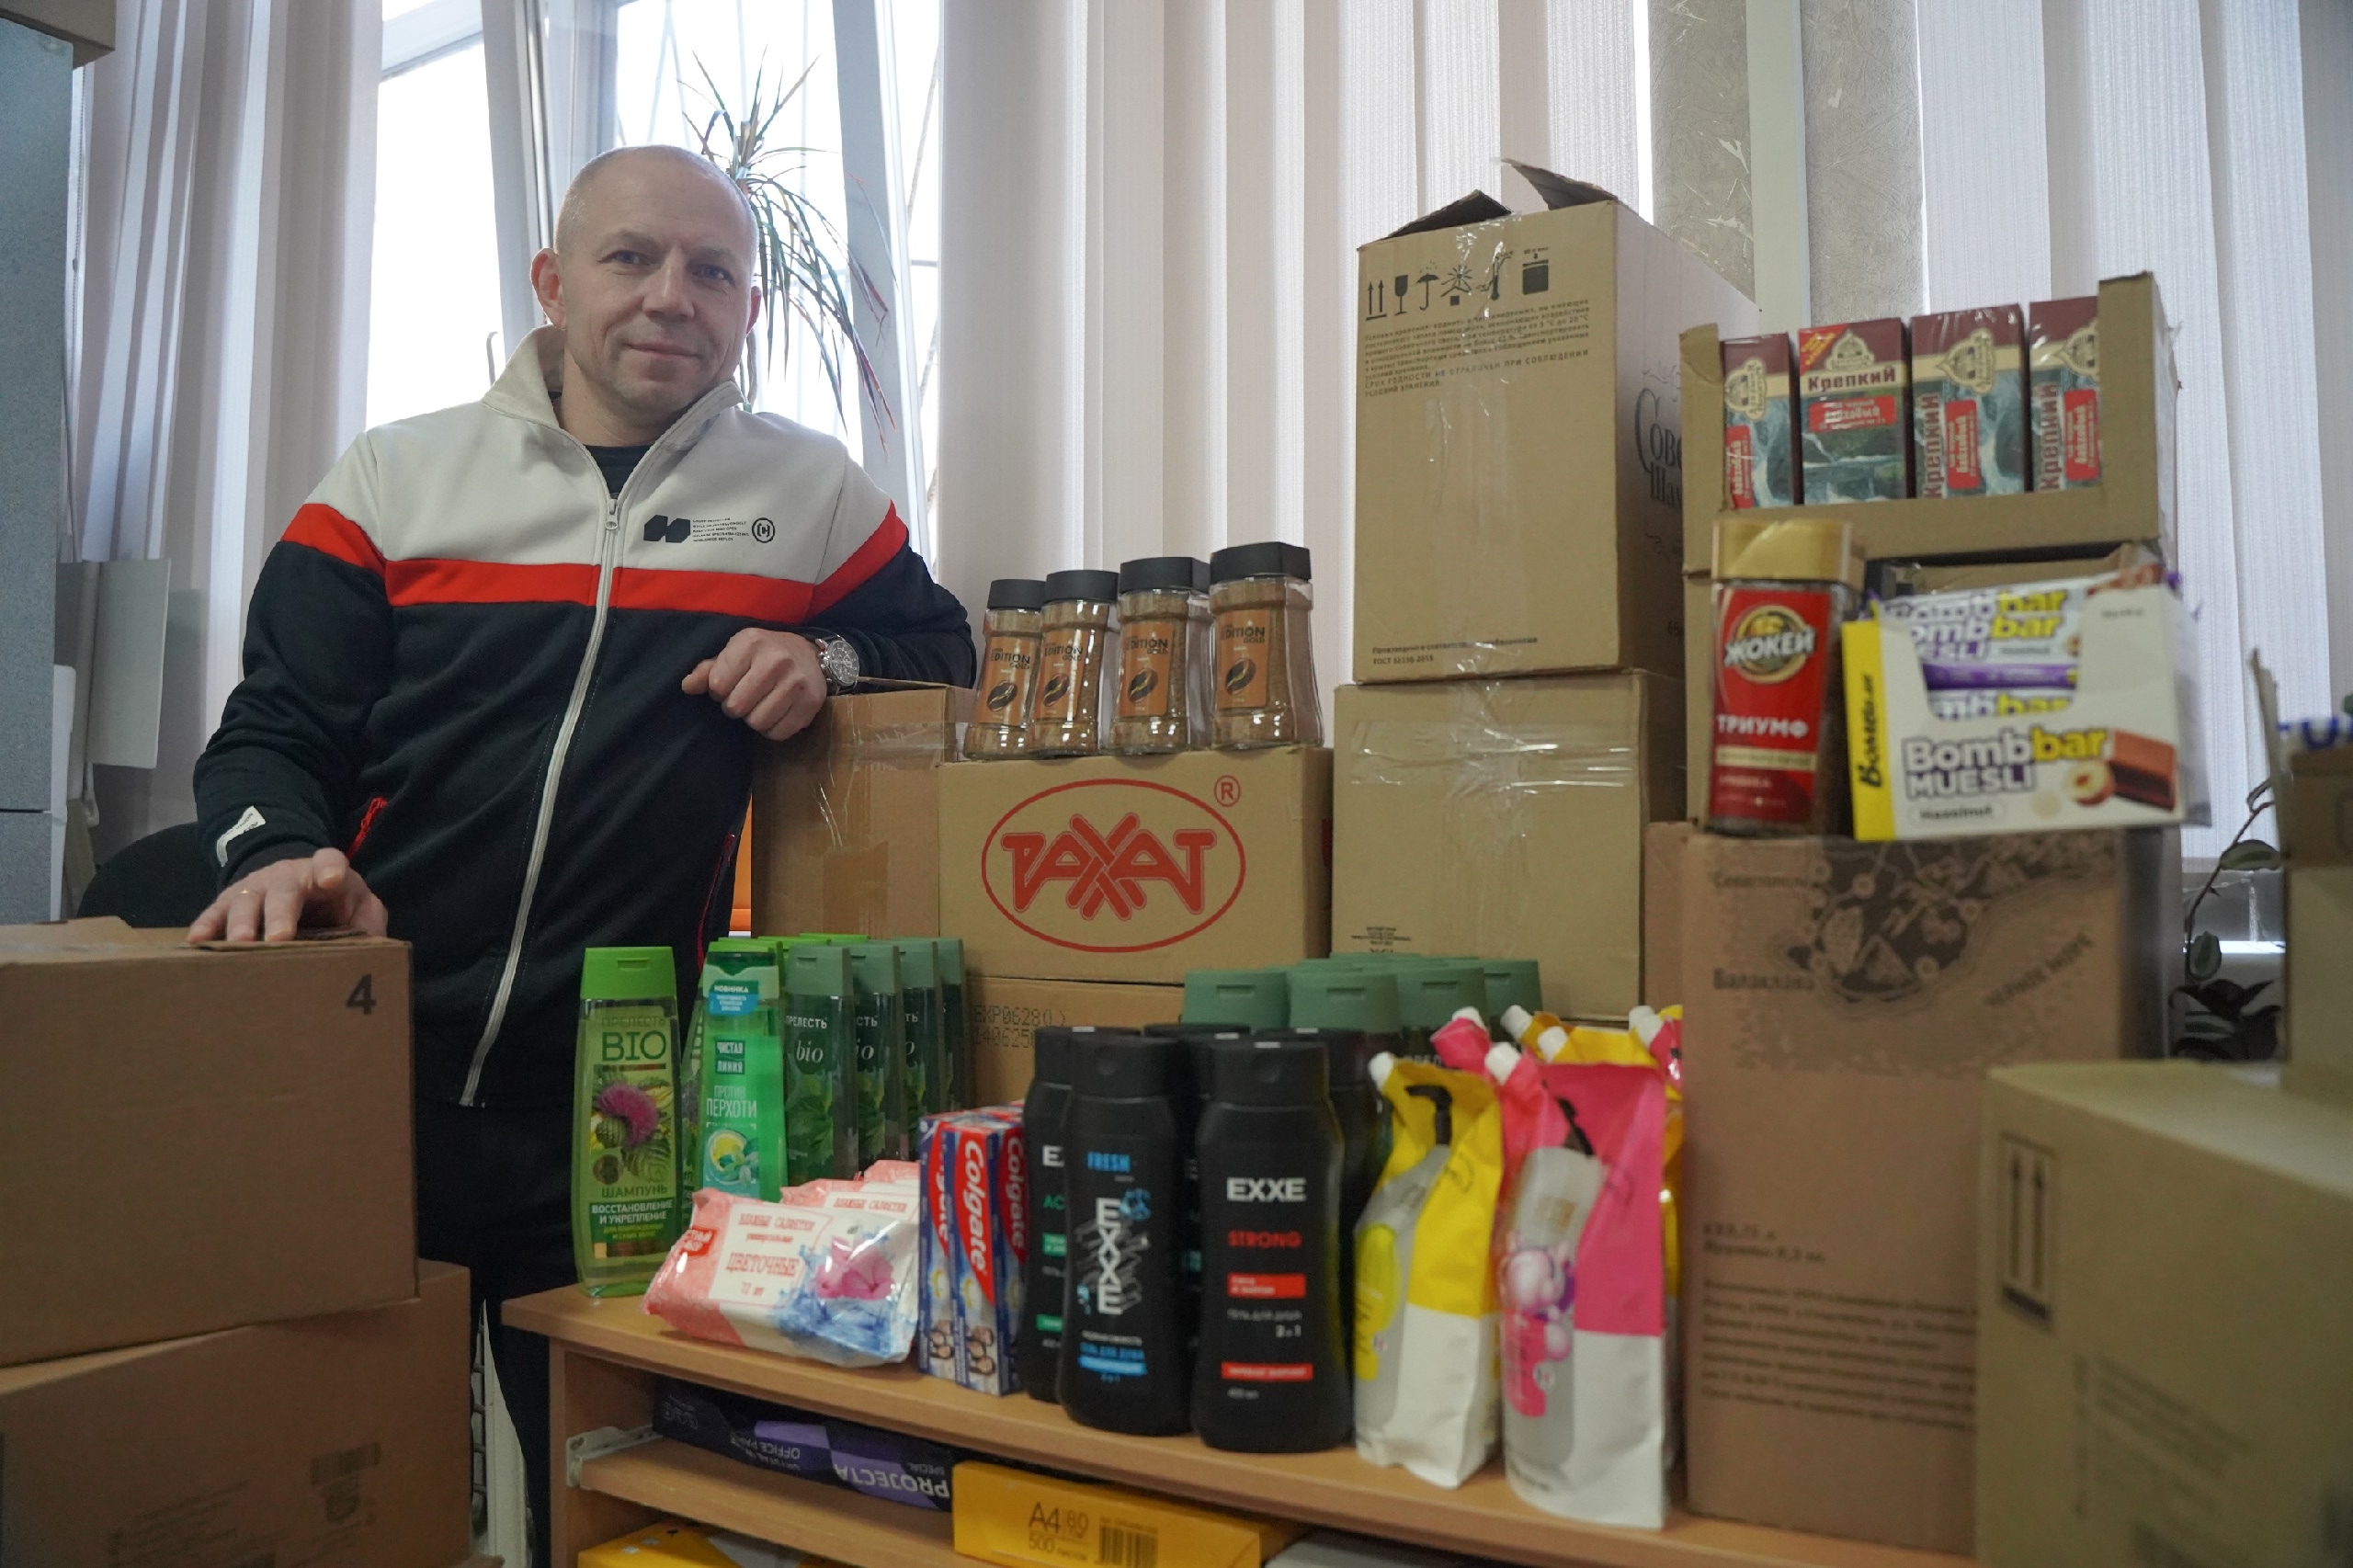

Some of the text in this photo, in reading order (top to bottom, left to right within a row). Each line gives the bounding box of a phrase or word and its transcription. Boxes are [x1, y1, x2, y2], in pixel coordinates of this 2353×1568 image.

[1807, 367, 1896, 392] Крепкий
[1921, 393, 1945, 498] Крепкий
[2039, 382, 2062, 491] Крепкий
[1724, 623, 1817, 668] ЖОКЕЙ
[1716, 714, 1810, 739] ТРИУМФ
[1900, 725, 2108, 772] Bombbar
[1905, 762, 2038, 801] MUESLI
[346, 974, 377, 1016] 4
[601, 1014, 667, 1028] ПРЕЛЕСТЬ
[785, 1015, 828, 1030] ПРЕЛЕСТЬ
[602, 1029, 667, 1062] BIO
[716, 1041, 745, 1054] ЧИСТАЯ
[796, 1040, 824, 1063] bio
[717, 1060, 744, 1074] ЛИНИЯ
[706, 1098, 757, 1119] ПЕРХОТИ
[601, 1183, 668, 1199] ШАМПУНЬ
[1006, 1136, 1026, 1250] Colgate
[1226, 1177, 1307, 1202] EXXE
[591, 1199, 673, 1214] ВОССТАНОВЛЕНИЕ
[599, 1210, 667, 1225] И УКРЕПЛЕНИЕ
[962, 1139, 987, 1272] Colgate
[774, 1214, 816, 1231] САЛФЕТКИ
[1226, 1229, 1303, 1249] STRONG
[725, 1252, 801, 1278] ЦВЕТОЧНЫЕ
[1095, 1198, 1123, 1315] EXXE
[833, 1463, 951, 1499] PROJECTA
[1029, 1501, 1061, 1532] A4
